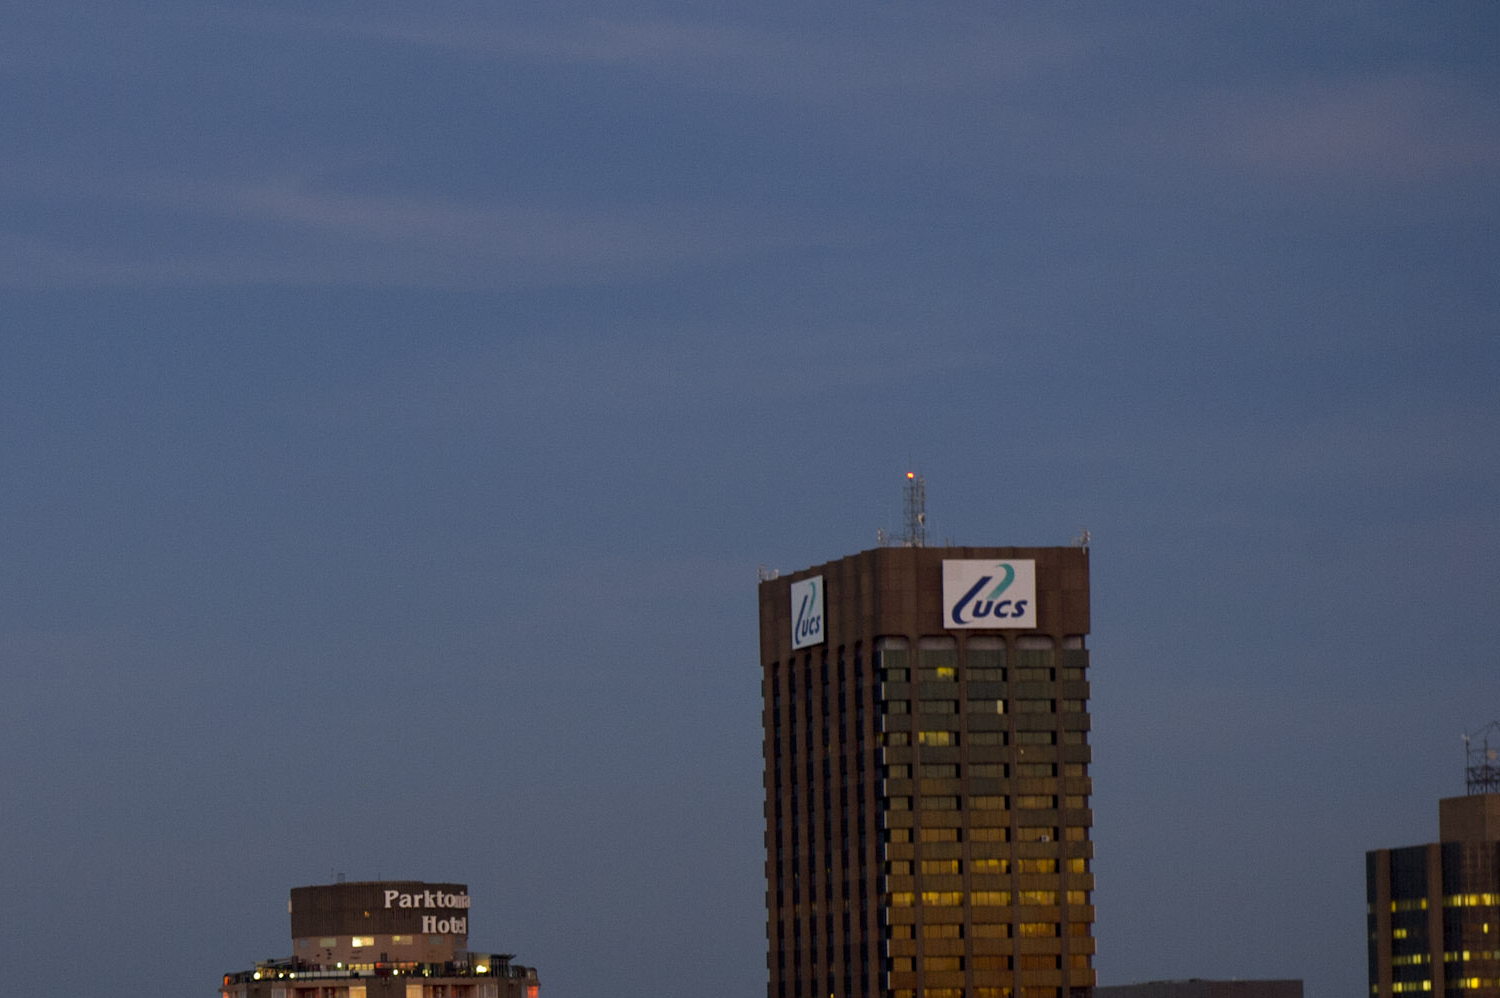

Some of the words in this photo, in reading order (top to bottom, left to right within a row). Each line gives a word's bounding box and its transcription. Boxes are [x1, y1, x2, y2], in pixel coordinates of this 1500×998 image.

[972, 599, 1028, 618] UCS
[801, 615, 821, 637] UCS
[384, 890, 471, 909] Parktonia
[422, 915, 467, 934] Hotel
